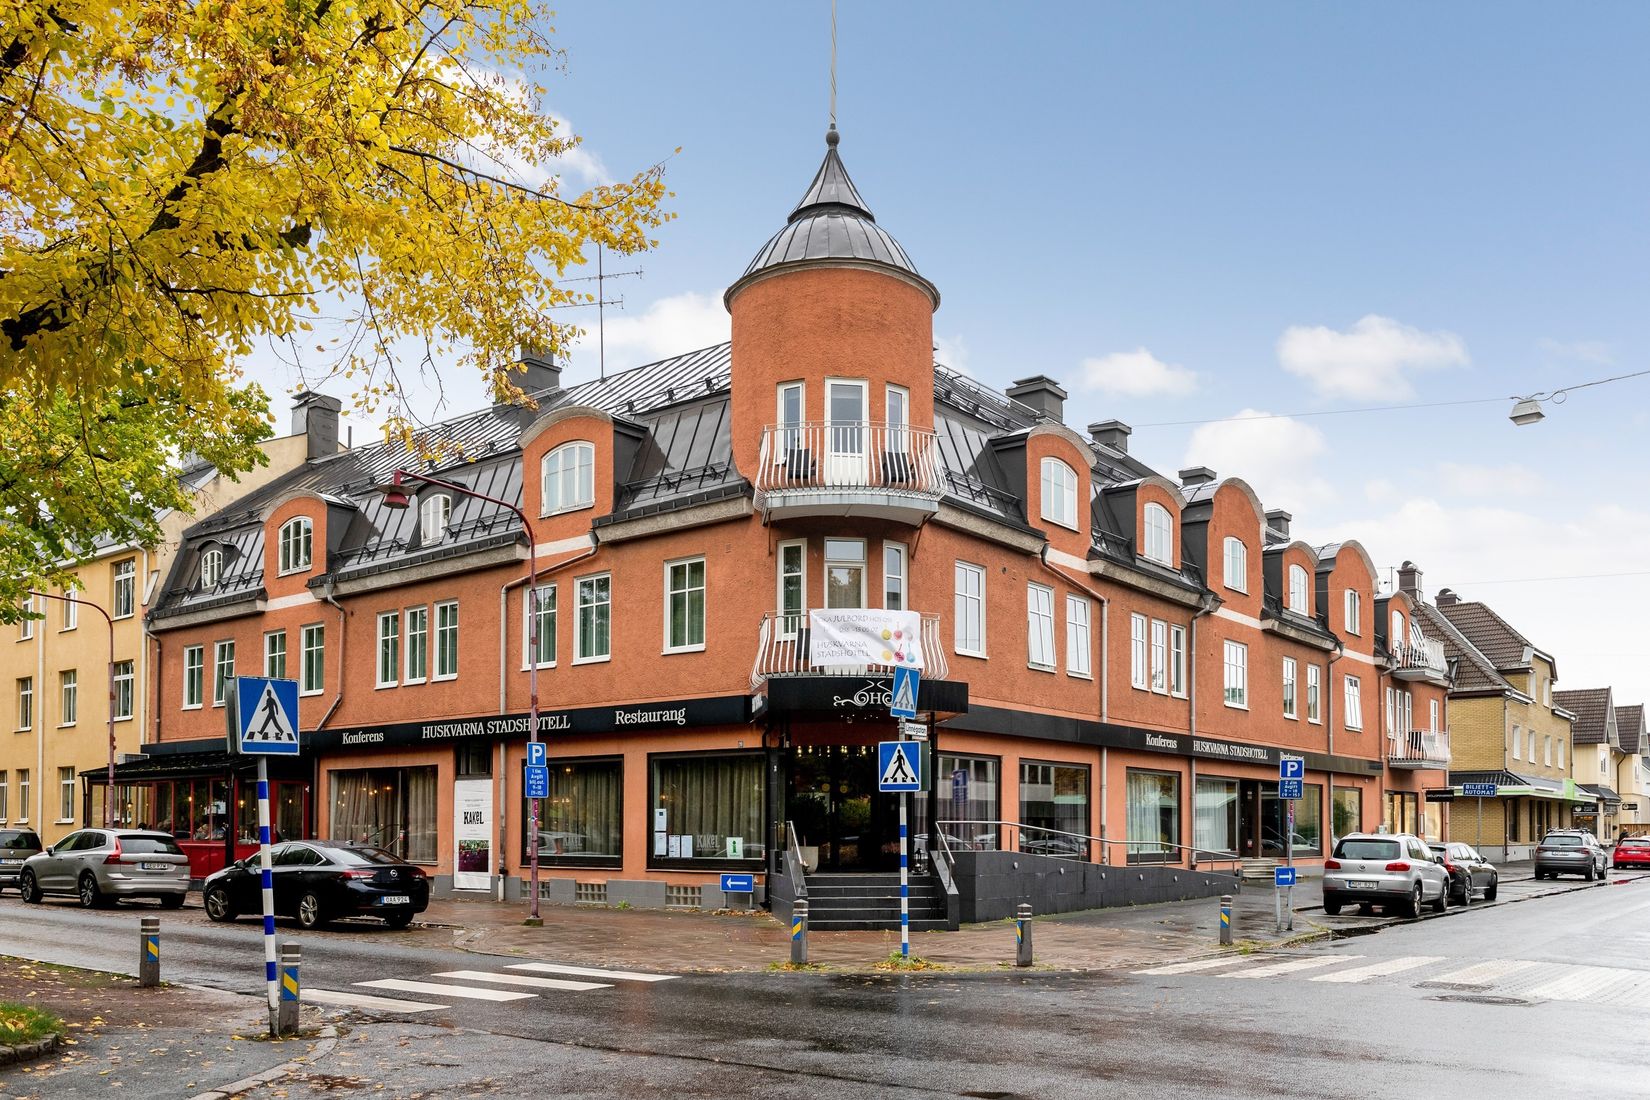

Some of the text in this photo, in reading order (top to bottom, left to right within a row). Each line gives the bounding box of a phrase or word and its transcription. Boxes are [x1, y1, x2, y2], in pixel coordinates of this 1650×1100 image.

[817, 640, 869, 649] HUSKVARNA
[817, 649, 871, 658] STADSHOTELL
[615, 708, 686, 725] Restaurang
[342, 730, 384, 745] Konferens
[422, 721, 485, 739] HUSKVARNA
[905, 725, 926, 735] Linnégatan
[1146, 733, 1177, 749] Konferens
[532, 745, 543, 764] P
[1193, 740, 1229, 755] HUSKVARNA
[1229, 746, 1268, 760] STADSHOTELL
[1287, 761, 1298, 777] P
